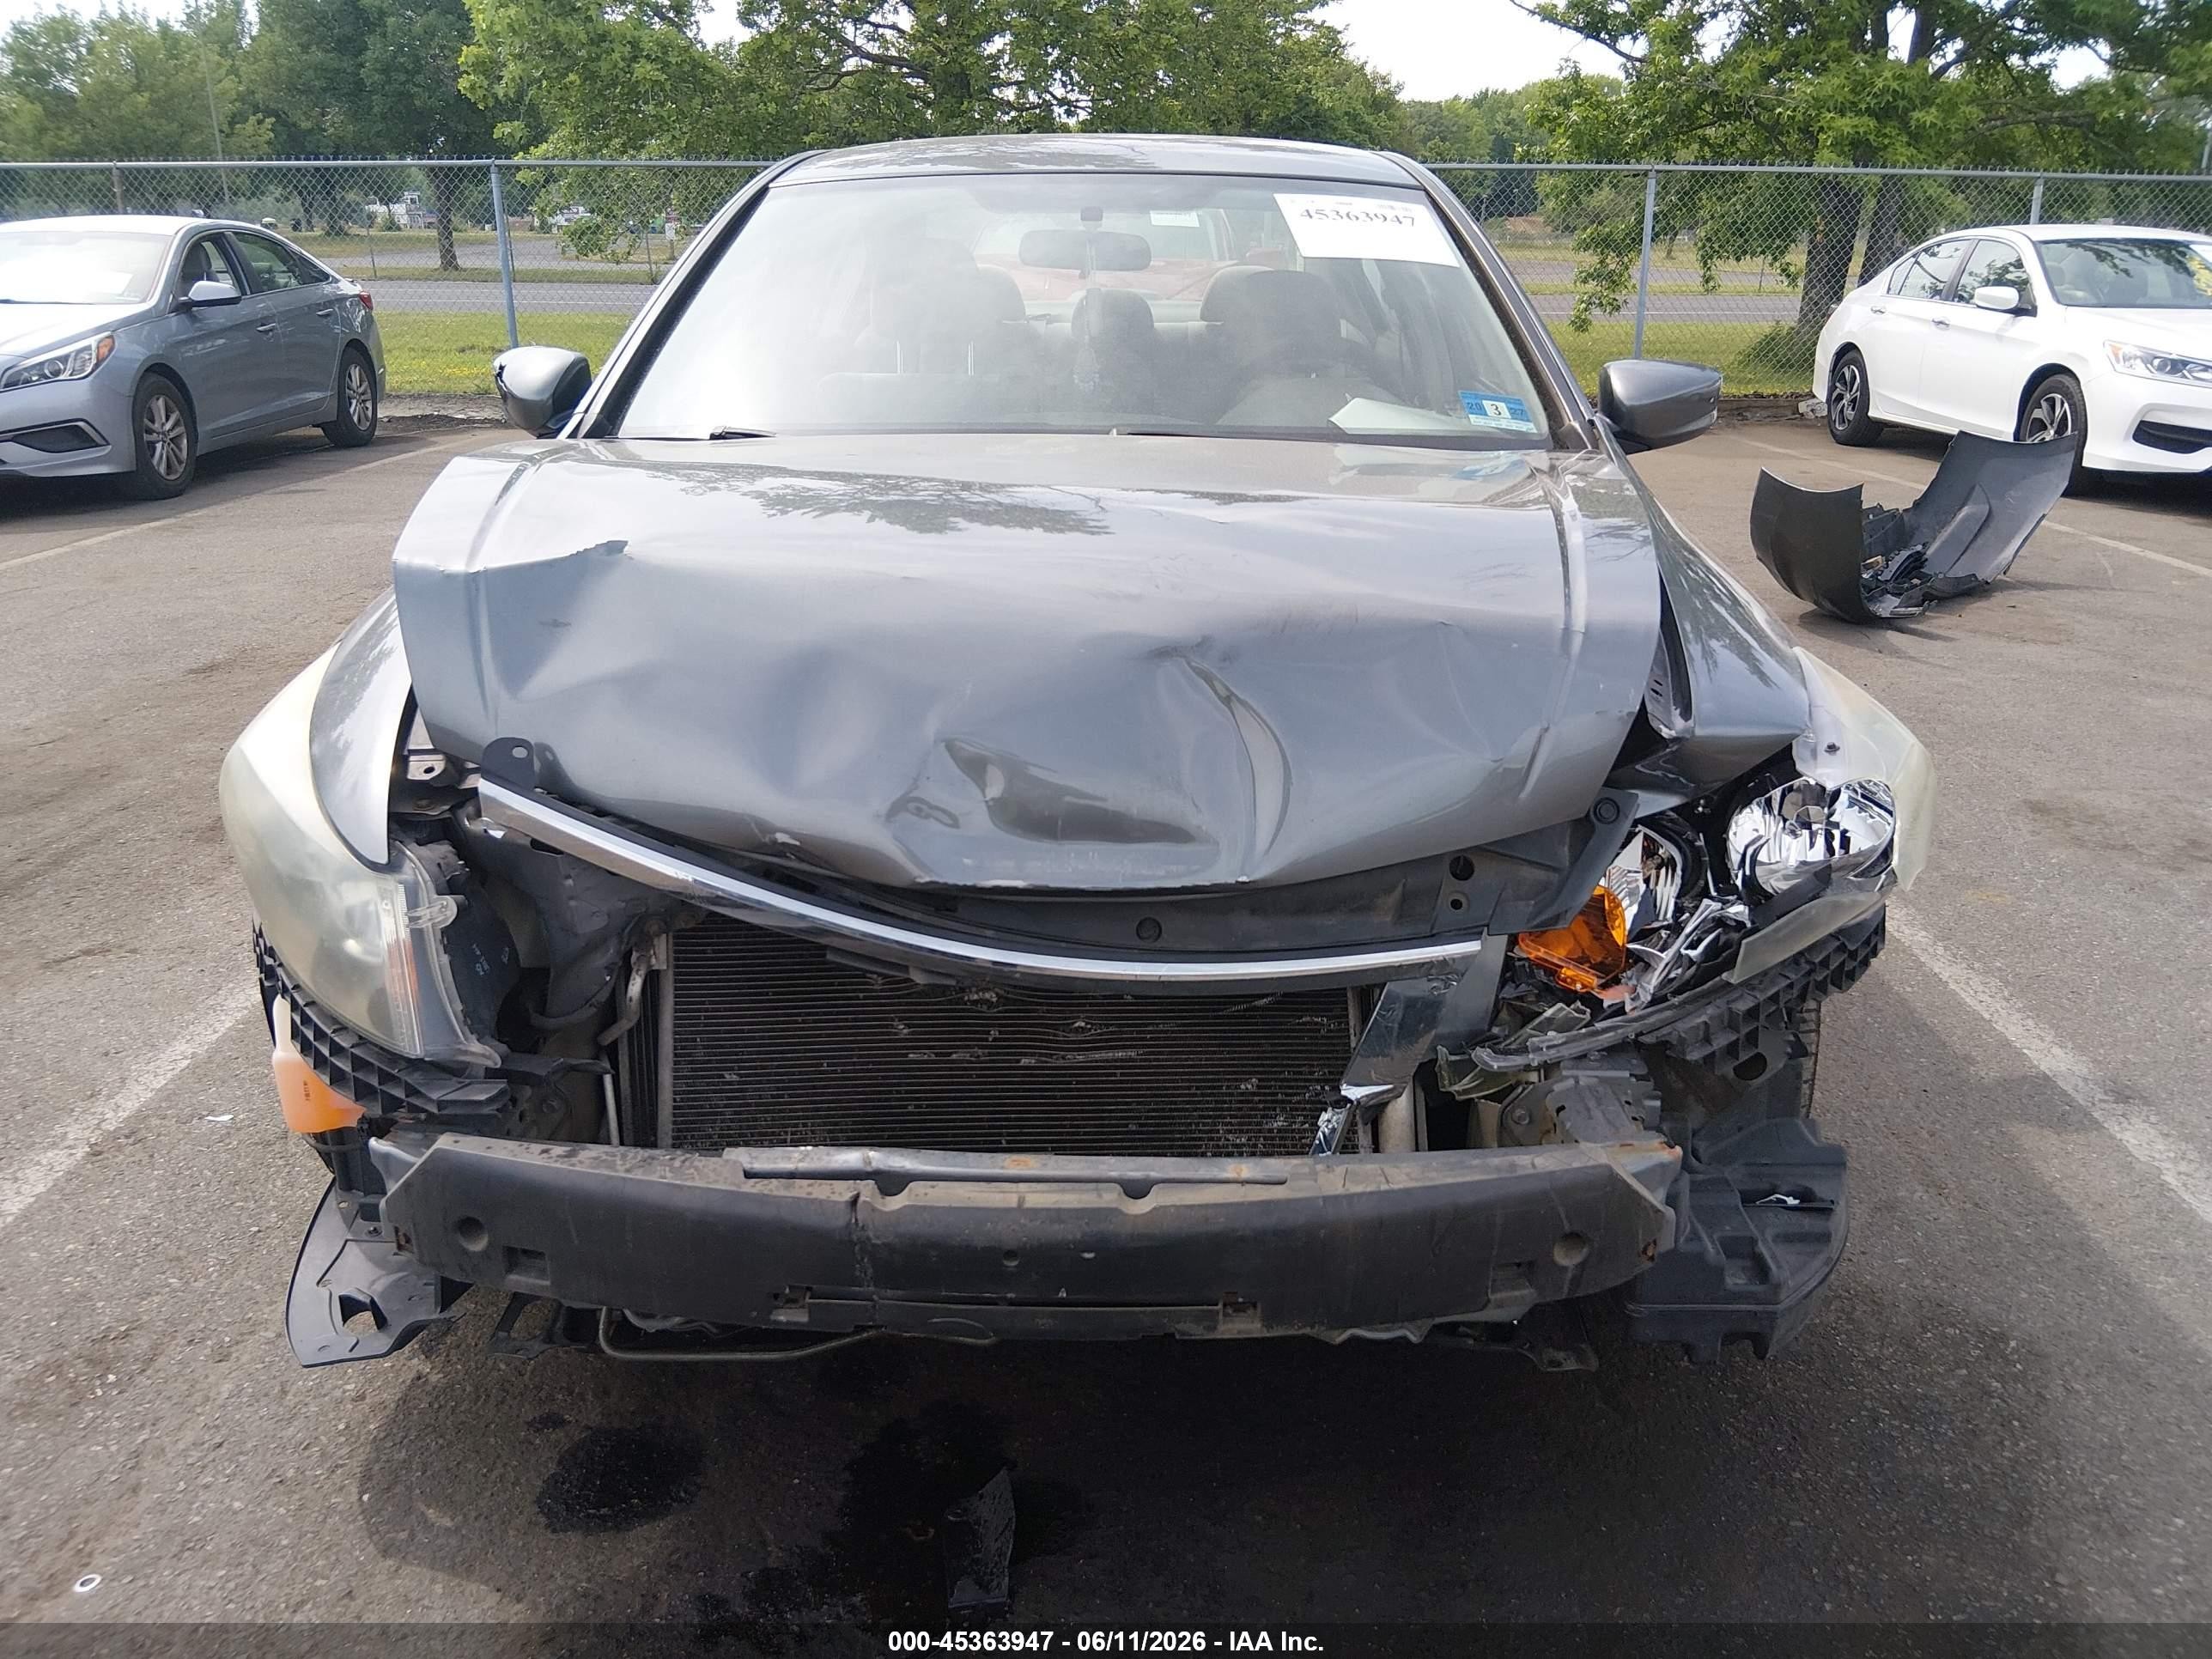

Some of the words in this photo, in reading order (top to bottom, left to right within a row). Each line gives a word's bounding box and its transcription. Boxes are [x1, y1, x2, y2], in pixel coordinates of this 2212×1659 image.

[1299, 208, 1415, 227] 45363947
[1467, 402, 1482, 411] 20
[1490, 404, 1502, 416] 3
